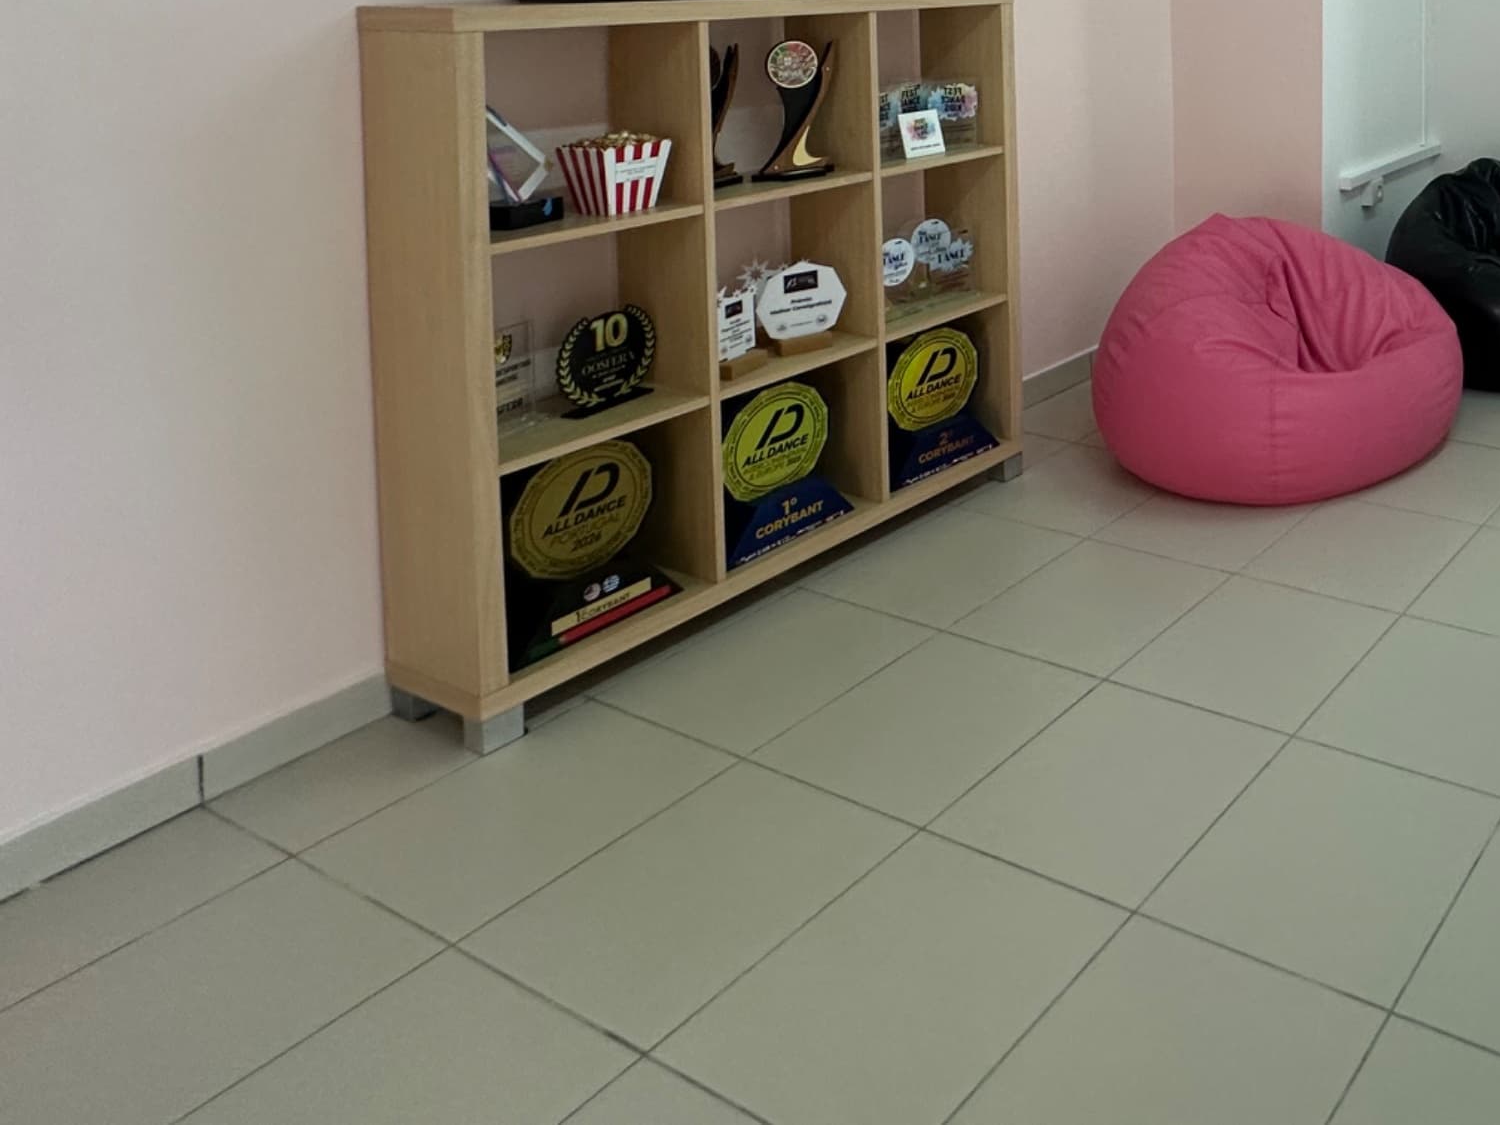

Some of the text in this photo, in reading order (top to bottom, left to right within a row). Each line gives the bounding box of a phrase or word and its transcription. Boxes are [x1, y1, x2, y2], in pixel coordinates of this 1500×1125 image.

[590, 313, 628, 352] 10
[906, 388, 925, 402] ALL
[926, 373, 963, 394] DANCE
[742, 452, 765, 469] ALL
[767, 433, 810, 459] DANCE
[542, 495, 627, 540] ALL DANCE
[755, 500, 824, 540] CORYBANT
